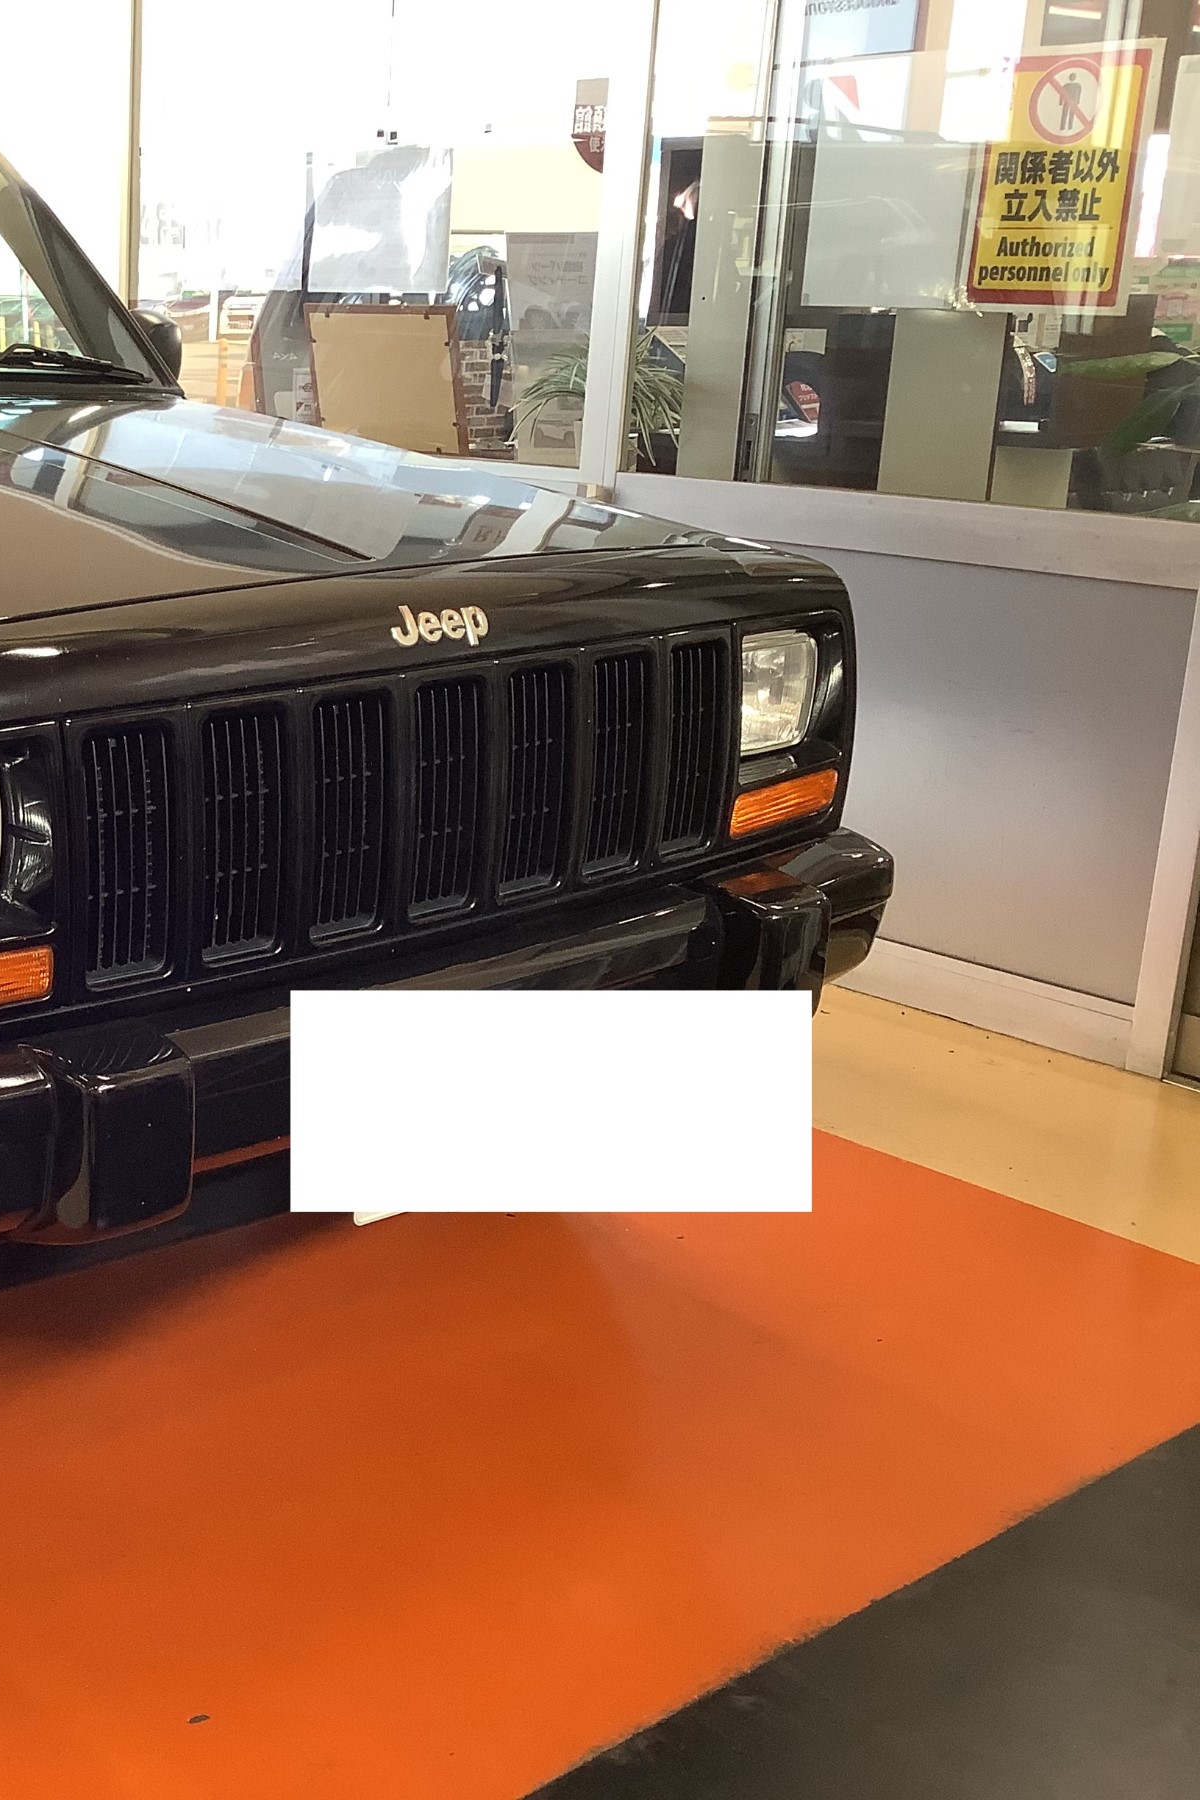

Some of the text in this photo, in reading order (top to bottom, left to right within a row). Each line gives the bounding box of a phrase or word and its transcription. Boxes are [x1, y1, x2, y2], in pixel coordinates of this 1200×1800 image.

[994, 149, 1120, 186] 関係者以外
[1000, 187, 1102, 223] 立入禁止
[996, 235, 1095, 258] Authorized
[978, 261, 1109, 288] personnel only
[390, 604, 489, 647] Jeep
